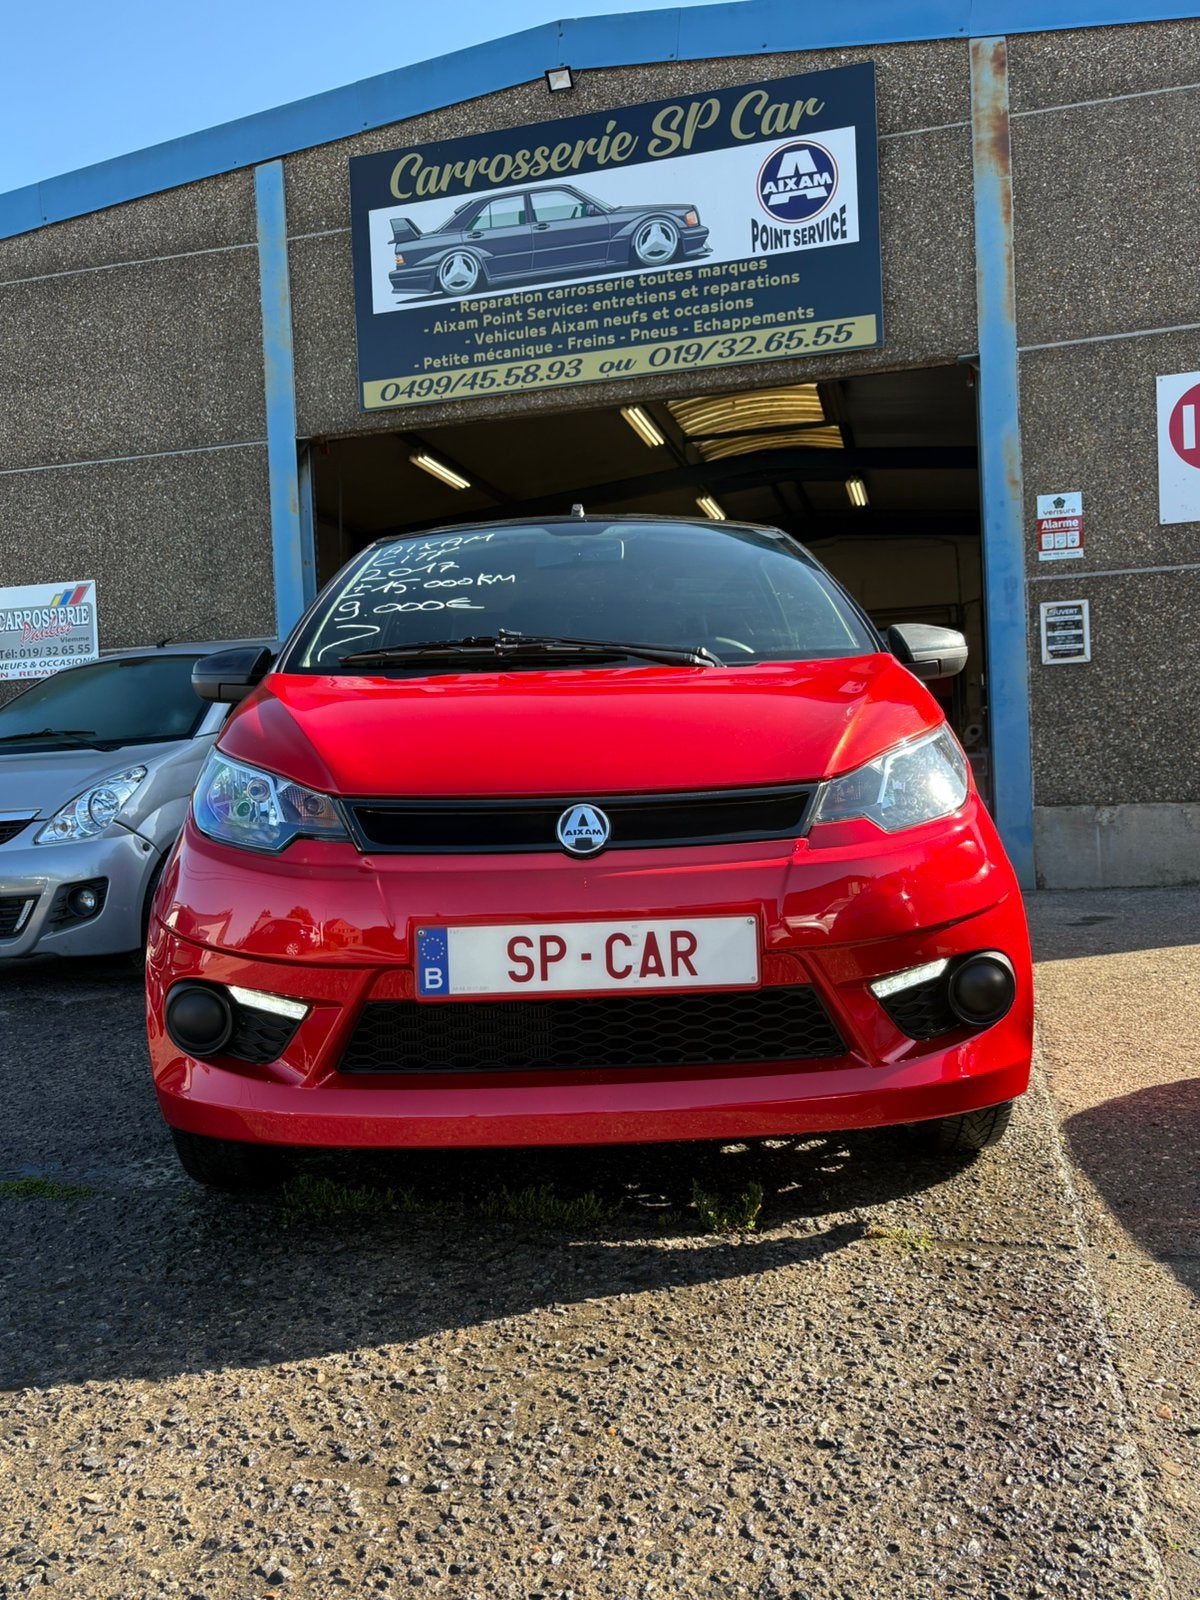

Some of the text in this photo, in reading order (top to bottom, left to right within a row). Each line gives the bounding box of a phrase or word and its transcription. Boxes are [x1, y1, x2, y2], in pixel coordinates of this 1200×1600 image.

[389, 89, 825, 199] Carrosserie SP Car
[762, 172, 833, 195] AIXAM
[751, 204, 847, 253] POINT SERVICE
[461, 292, 542, 313] Reparation
[547, 277, 635, 300] carrosserie
[639, 270, 693, 286] toutes
[698, 259, 768, 278] marques
[433, 318, 478, 334] Aixam
[483, 310, 523, 327] Point
[527, 303, 588, 320] Service:
[592, 287, 677, 312] entretiens
[681, 285, 698, 298] et
[703, 272, 800, 296] reparations
[475, 325, 546, 345] Vehicules
[551, 318, 598, 335] Aixam
[603, 310, 648, 328] neufs
[652, 306, 670, 320] et
[674, 297, 754, 318] occasions
[424, 354, 469, 369] Petite
[473, 343, 553, 363] mécanique
[567, 333, 615, 350] Freins
[630, 325, 678, 342] Pneus
[693, 307, 815, 333] Echappements
[380, 322, 855, 401] 0499/45.58.93 ou 019/32.65.55
[1043, 508, 1076, 516] verisure
[1041, 519, 1079, 530] Alarme
[383, 534, 495, 556] AIXAM
[360, 561, 460, 581] 2017
[0, 605, 90, 632] CARROSSERIE
[334, 597, 485, 621] 9.000€
[0, 644, 91, 659] Tél: 019/ 32 65 55
[0, 662, 28, 670] NEUFS
[424, 967, 443, 989] B
